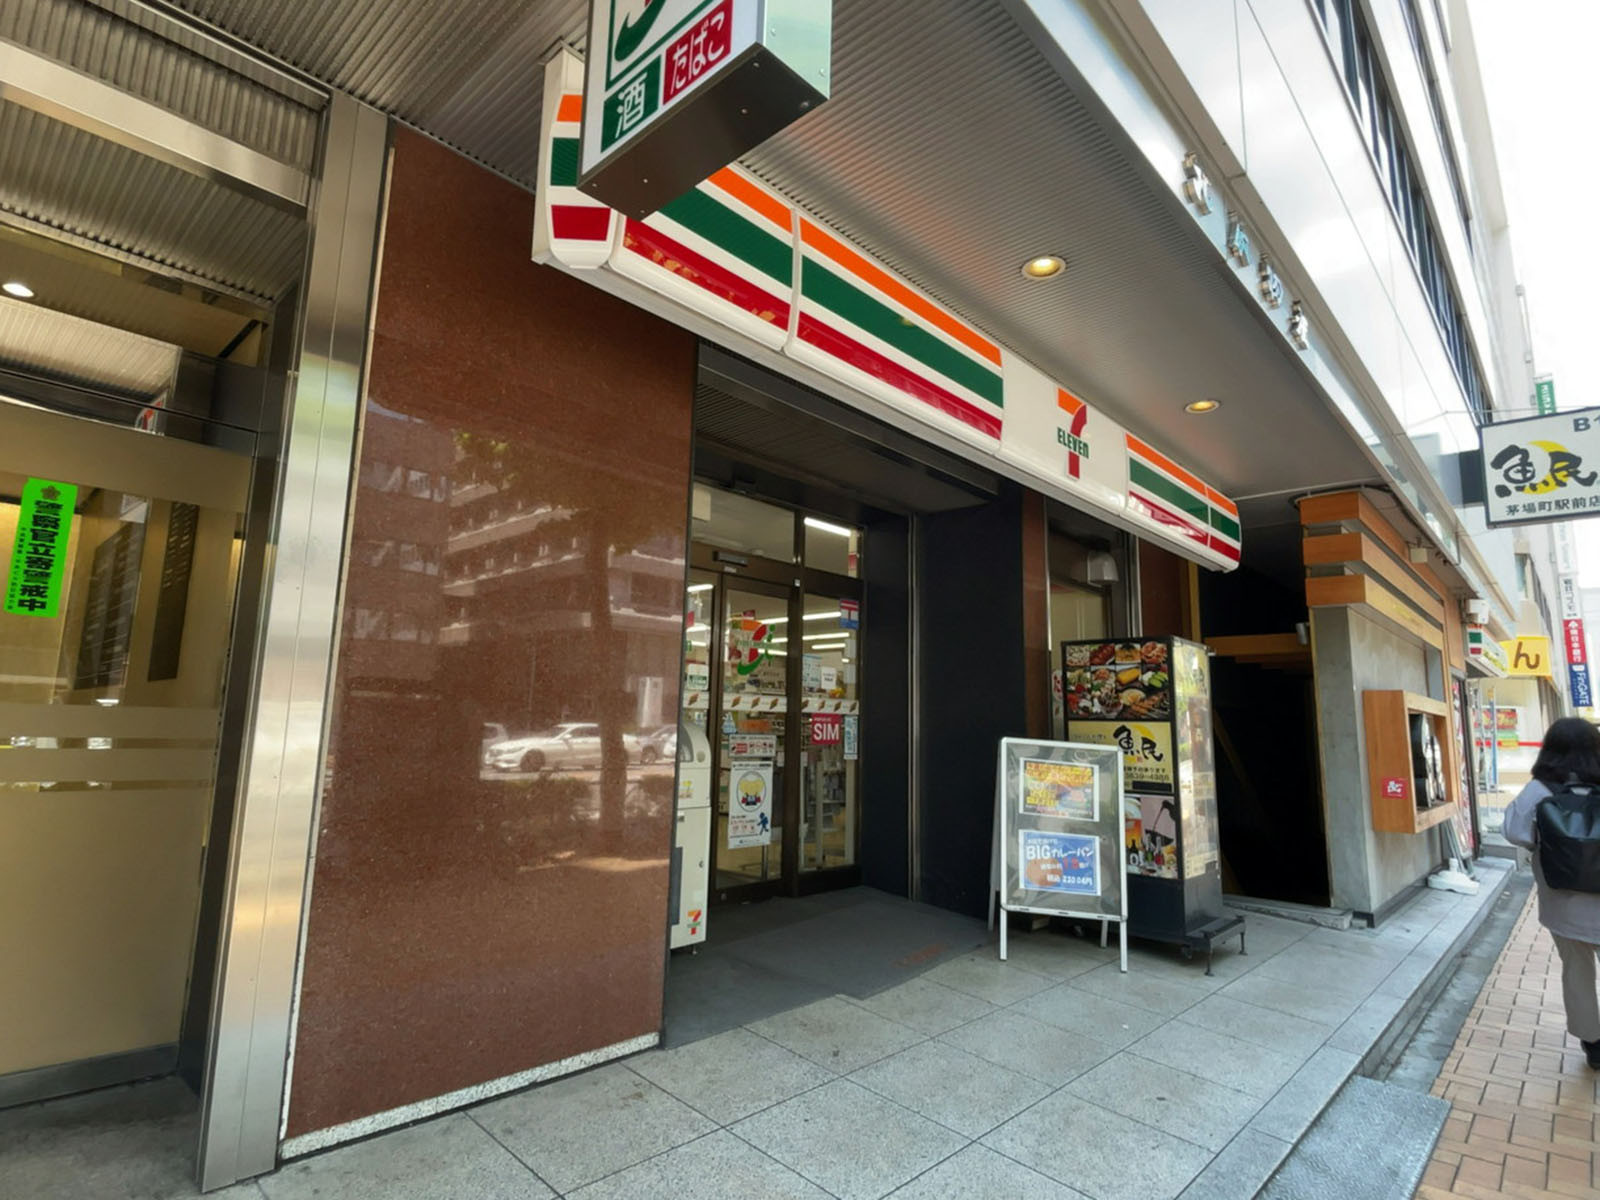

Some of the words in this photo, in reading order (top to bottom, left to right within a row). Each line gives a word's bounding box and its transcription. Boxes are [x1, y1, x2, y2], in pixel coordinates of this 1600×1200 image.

[669, 11, 725, 95] たばこ
[615, 73, 648, 138] 酒
[1490, 444, 1598, 498] 魚民
[1513, 641, 1541, 669] ん
[813, 723, 840, 741] SIM
[1112, 725, 1164, 762] 魚民
[1026, 844, 1095, 860] BIGカレーパン
